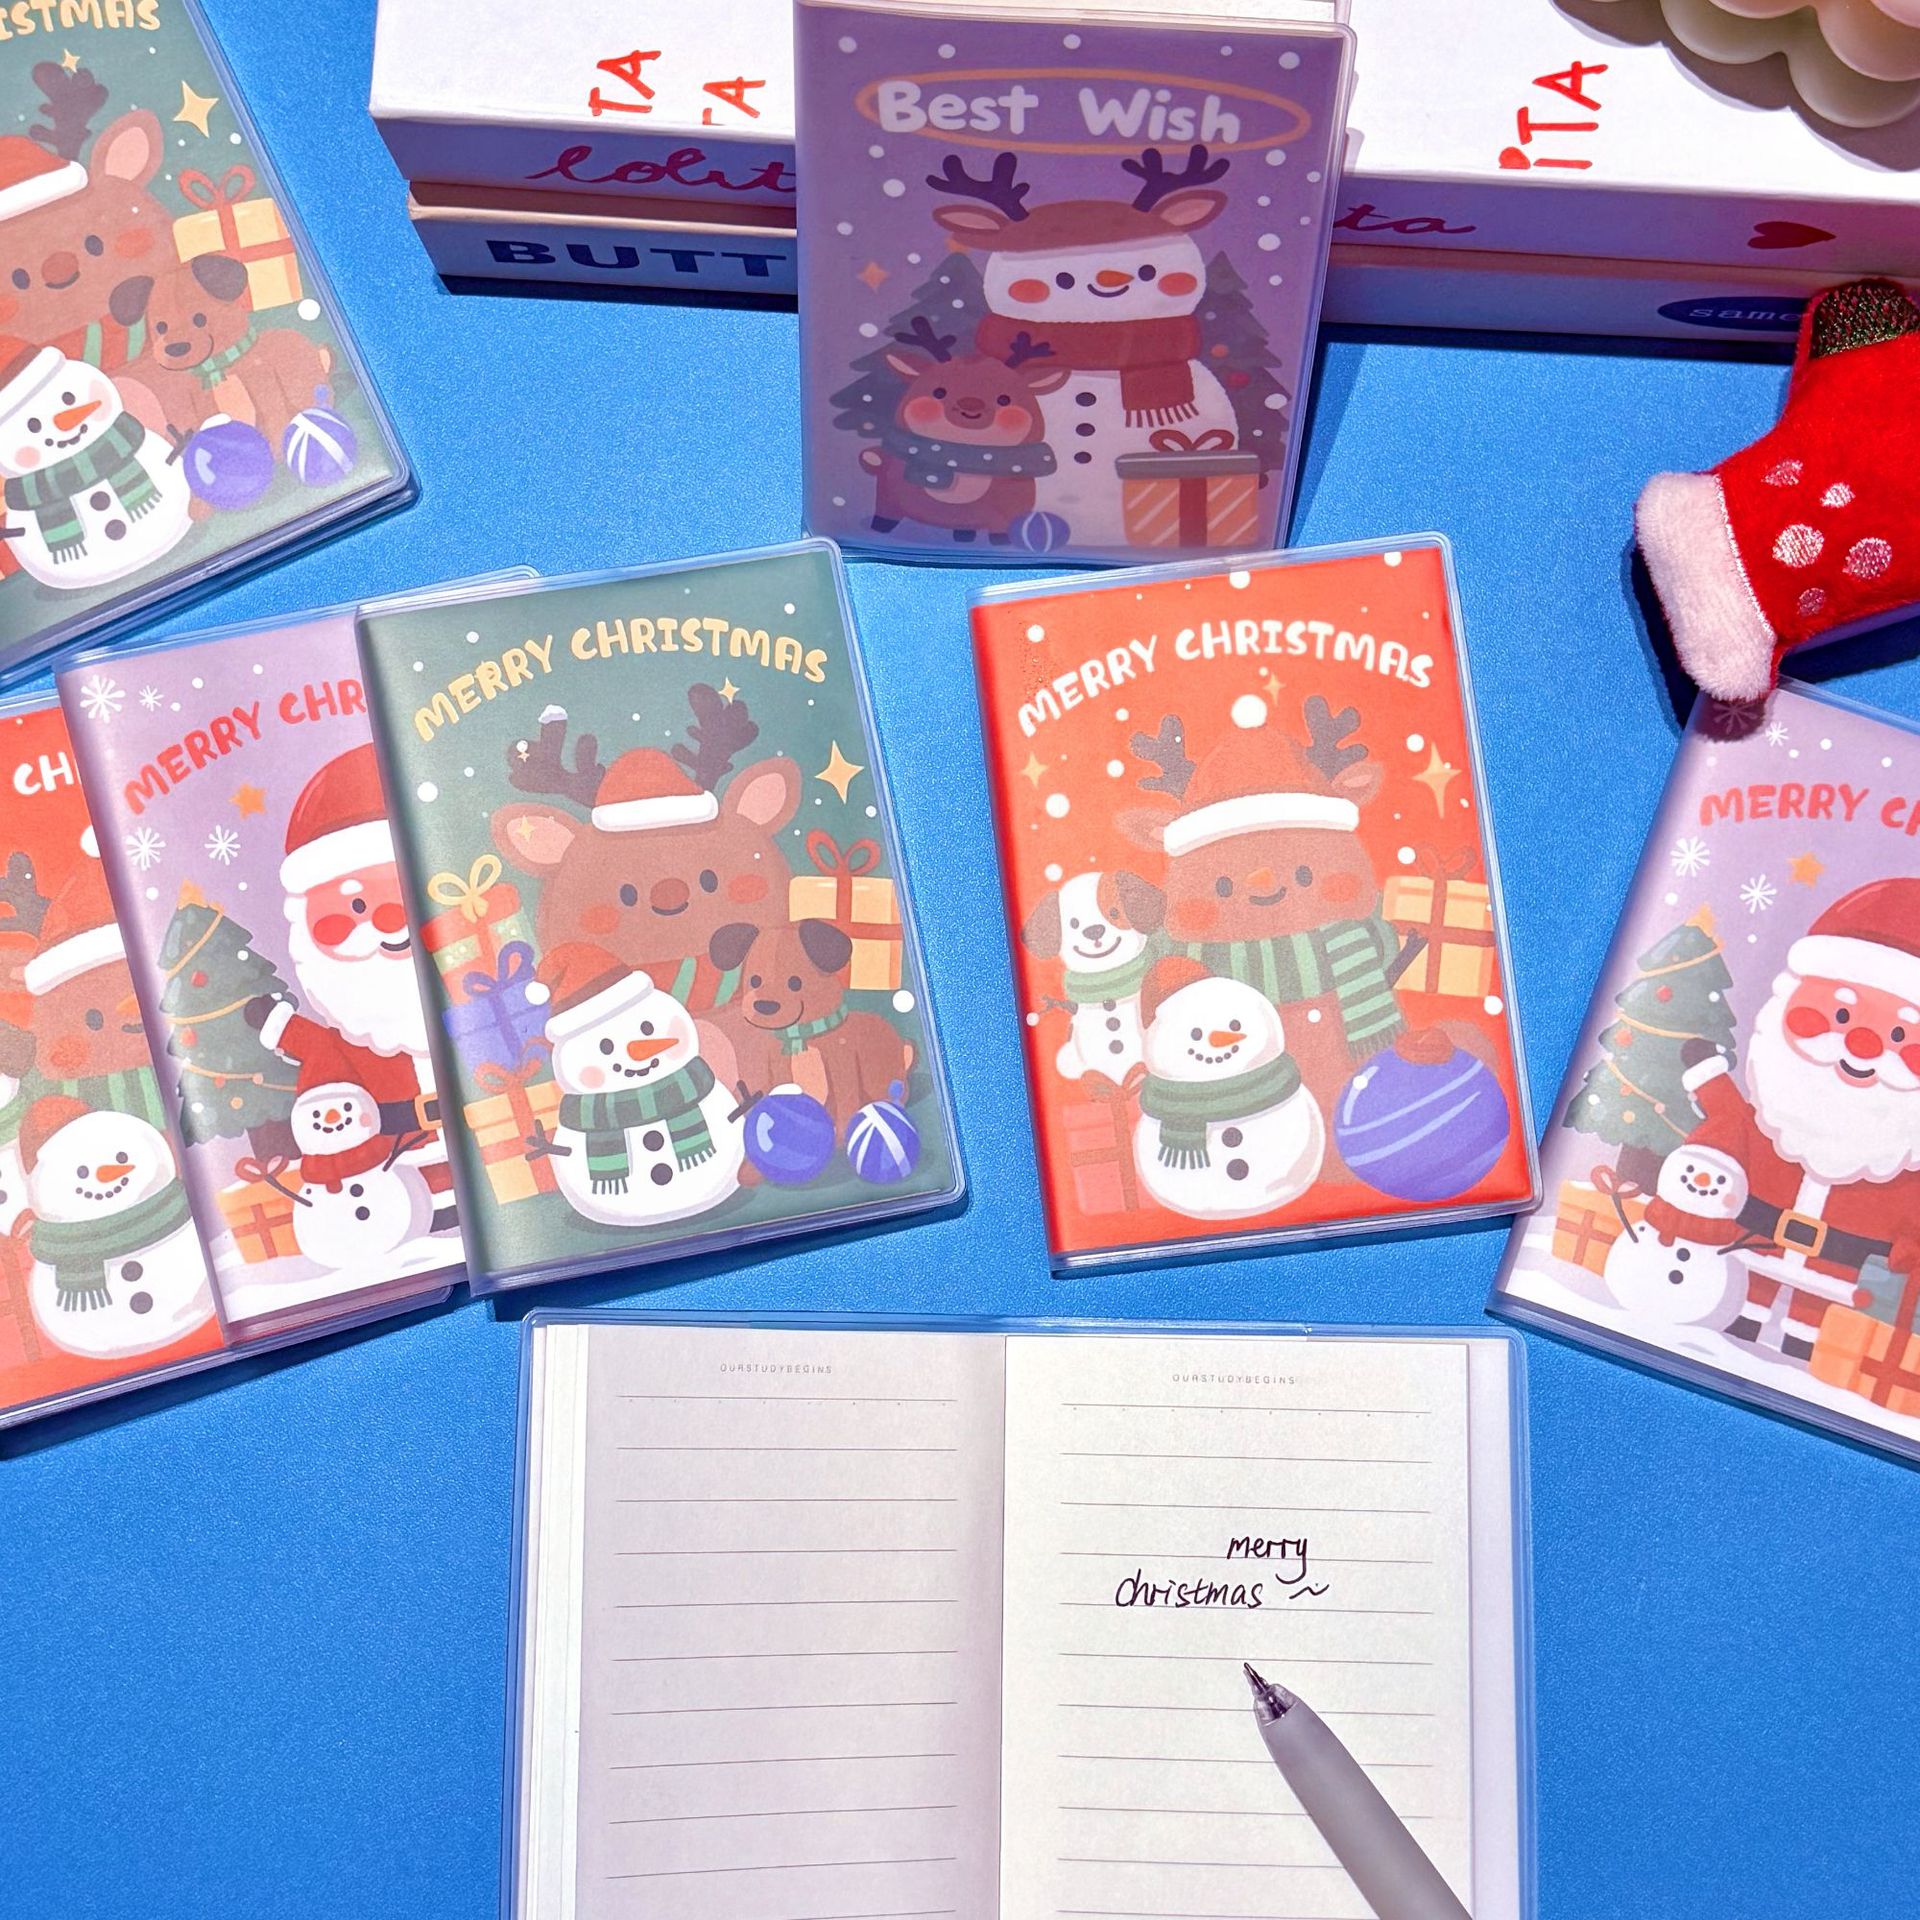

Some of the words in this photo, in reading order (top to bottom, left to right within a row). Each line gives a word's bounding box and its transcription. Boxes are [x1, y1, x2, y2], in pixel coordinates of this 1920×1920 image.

[588, 50, 661, 116] TA
[878, 81, 1039, 134] Best
[1079, 88, 1240, 144] Wish
[485, 239, 787, 277] BUTT
[414, 635, 553, 742] MERRY
[570, 617, 828, 684] CHRISTMAS
[1017, 635, 1157, 738] MERRY
[1174, 619, 1434, 688] CHRISTMAS
[124, 701, 261, 816] MERRY
[278, 679, 366, 725] CHR
[1699, 782, 1869, 826] MERRY
[1115, 1568, 1263, 1609] christmas
[1226, 1536, 1308, 1585] merry
